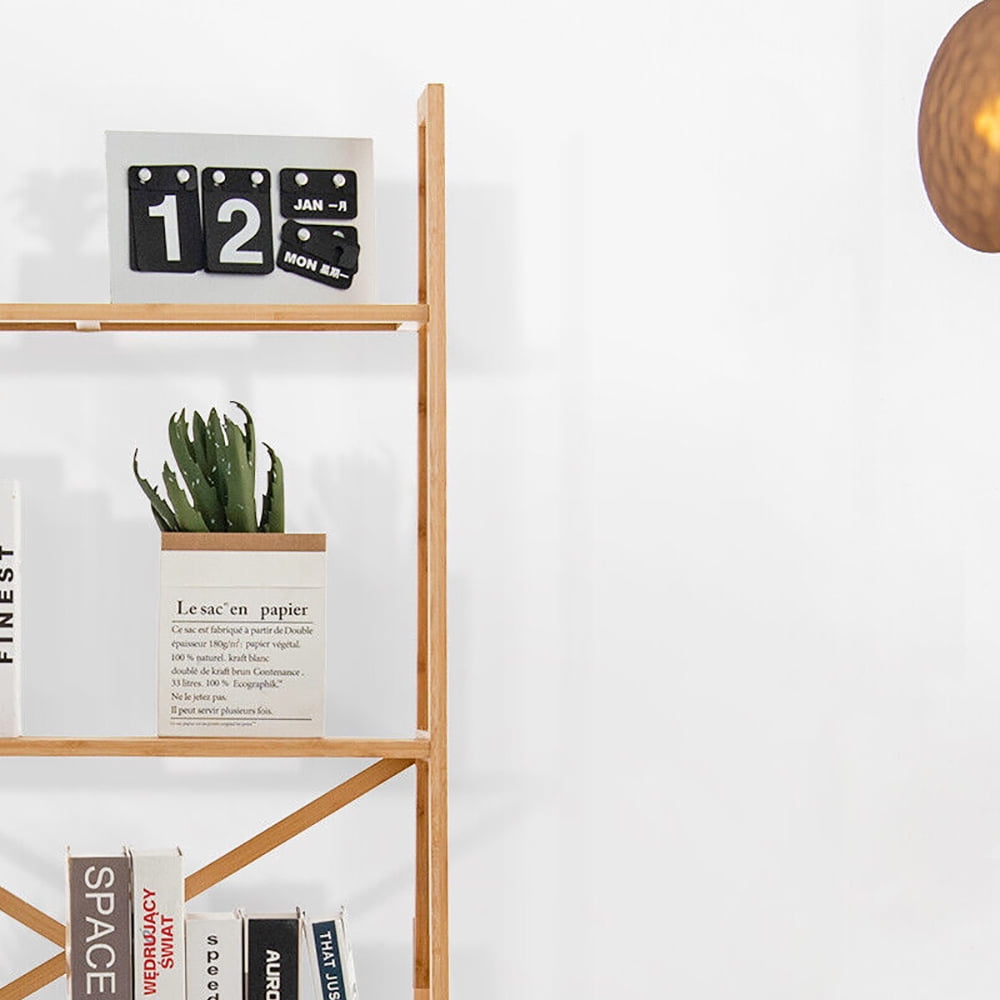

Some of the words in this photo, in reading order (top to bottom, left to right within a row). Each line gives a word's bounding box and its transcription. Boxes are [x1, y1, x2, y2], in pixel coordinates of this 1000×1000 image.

[293, 199, 324, 212] JAN
[148, 194, 182, 262] 1
[216, 198, 263, 264] 2
[284, 251, 318, 273] MON
[177, 600, 197, 615] Le
[230, 605, 248, 616] en
[260, 602, 309, 620] papier
[171, 625, 182, 634] Ce
[184, 626, 196, 634] sac
[198, 625, 208, 634] est
[250, 625, 273, 636] partir
[273, 625, 283, 634] de
[284, 625, 313, 635] Double
[245, 639, 270, 650] papier
[171, 653, 185, 662] 100
[228, 653, 247, 662] kraft
[248, 653, 270, 662] blanc
[200, 667, 210, 676] de
[211, 667, 230, 676] kraft
[231, 667, 251, 676] brun
[206, 679, 220, 688] 100
[171, 692, 183, 701] Ne
[184, 692, 192, 701] le
[178, 706, 196, 716] peut
[198, 706, 219, 715] servir
[220, 706, 256, 716] plusieurs
[84, 865, 116, 995] SPACE
[142, 888, 160, 996] WĘDRUJĄCY
[157, 914, 174, 970] ŚWIAT
[318, 930, 337, 969] THAT
